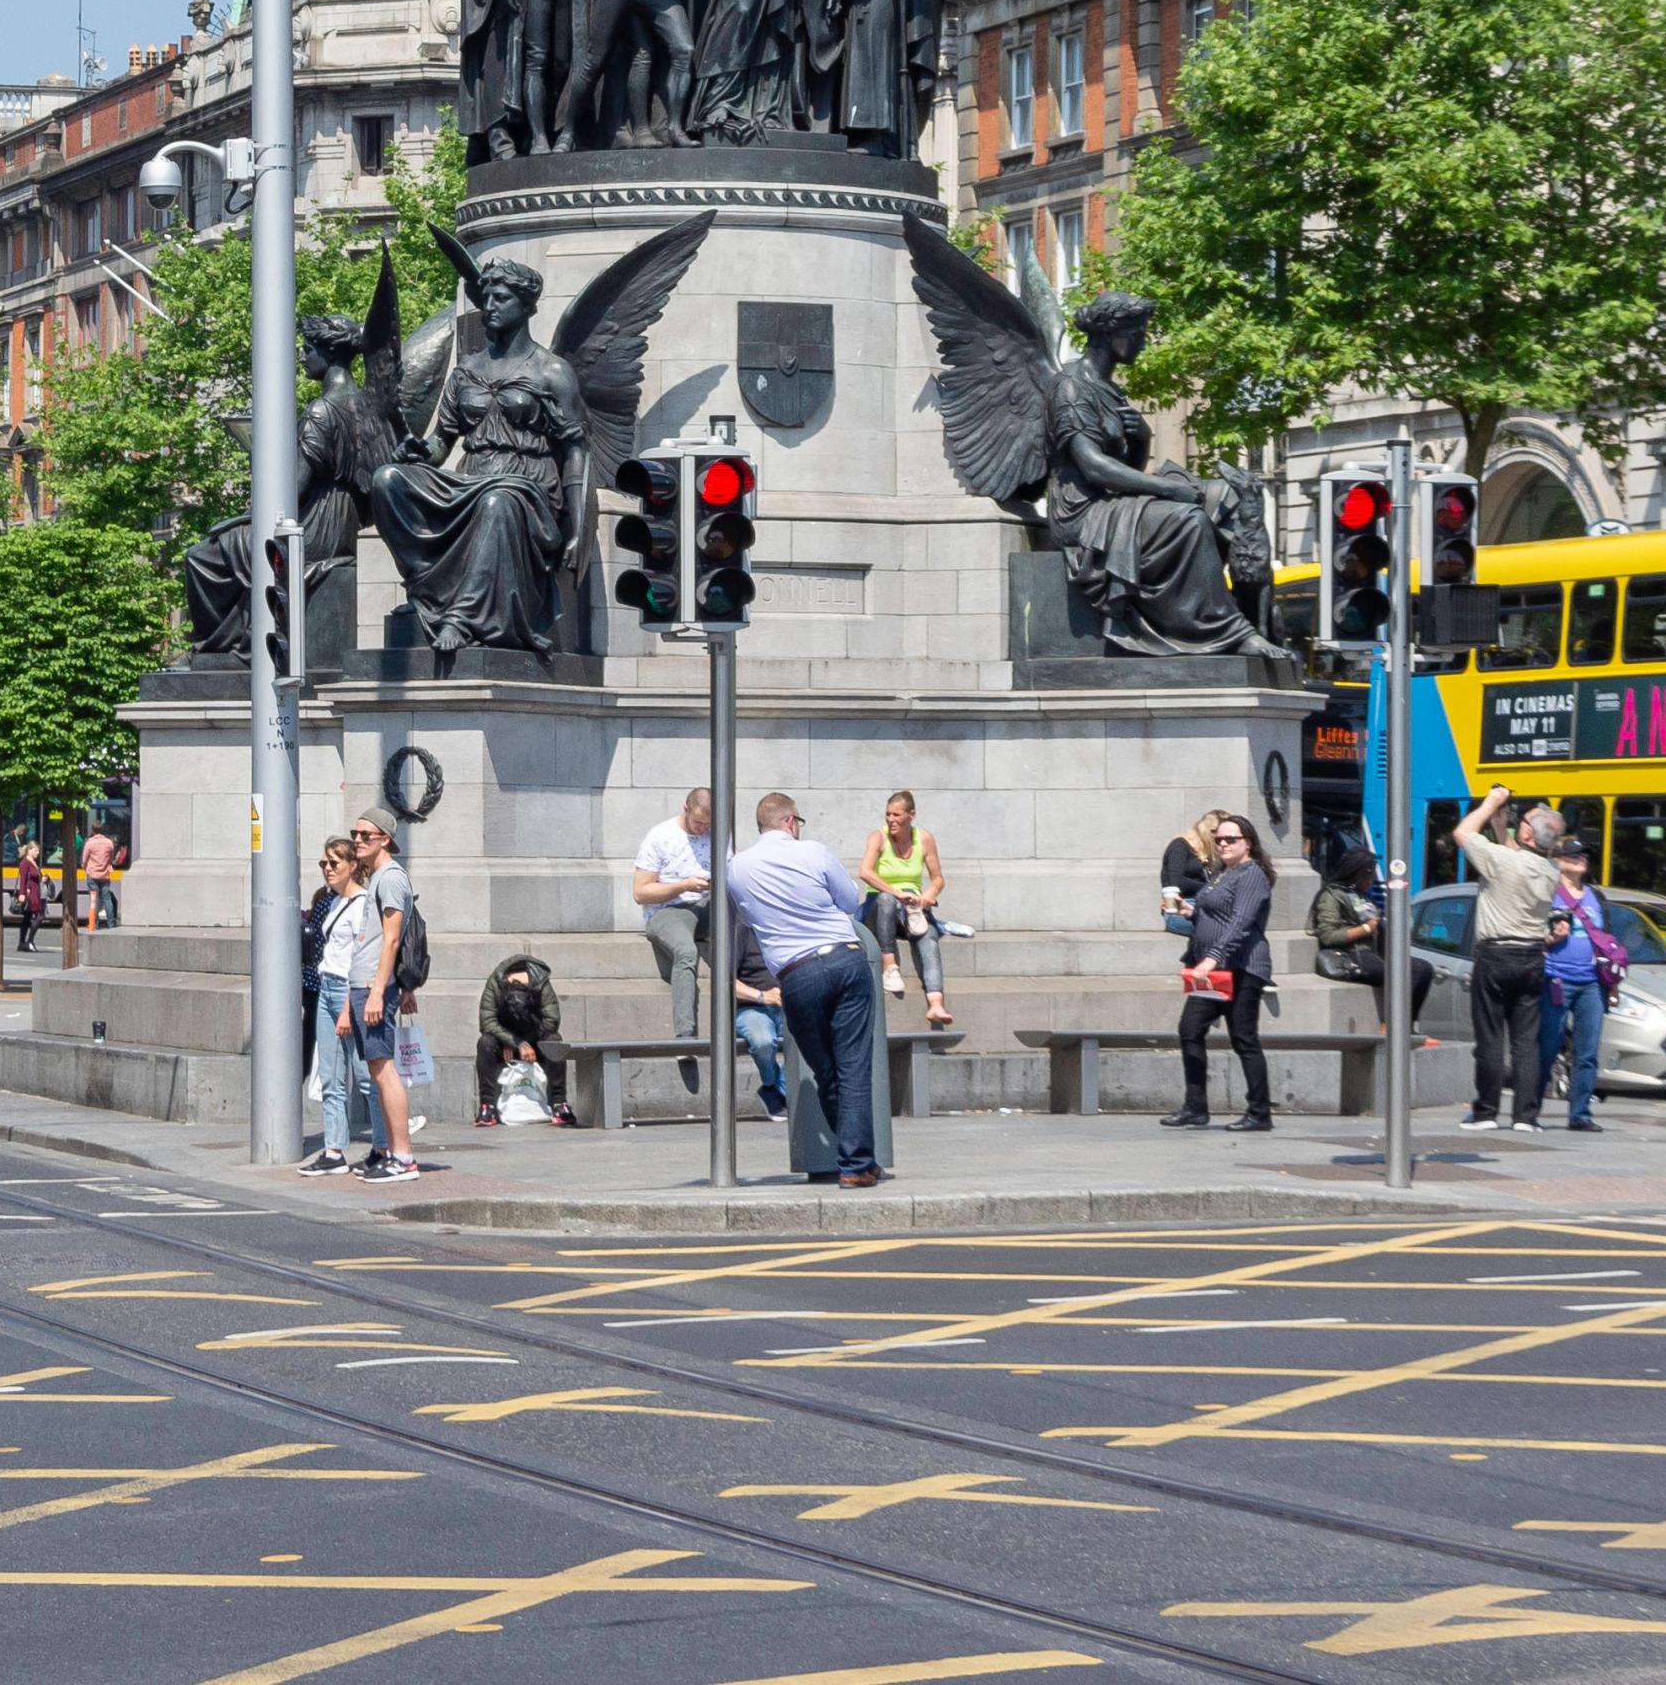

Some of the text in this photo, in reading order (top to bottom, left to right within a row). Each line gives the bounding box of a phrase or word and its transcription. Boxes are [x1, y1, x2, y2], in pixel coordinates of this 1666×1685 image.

[1495, 694, 1574, 715] IN CINEMAS
[268, 716, 291, 726] LCC
[1510, 716, 1556, 735] MAY 11
[276, 729, 285, 738] N
